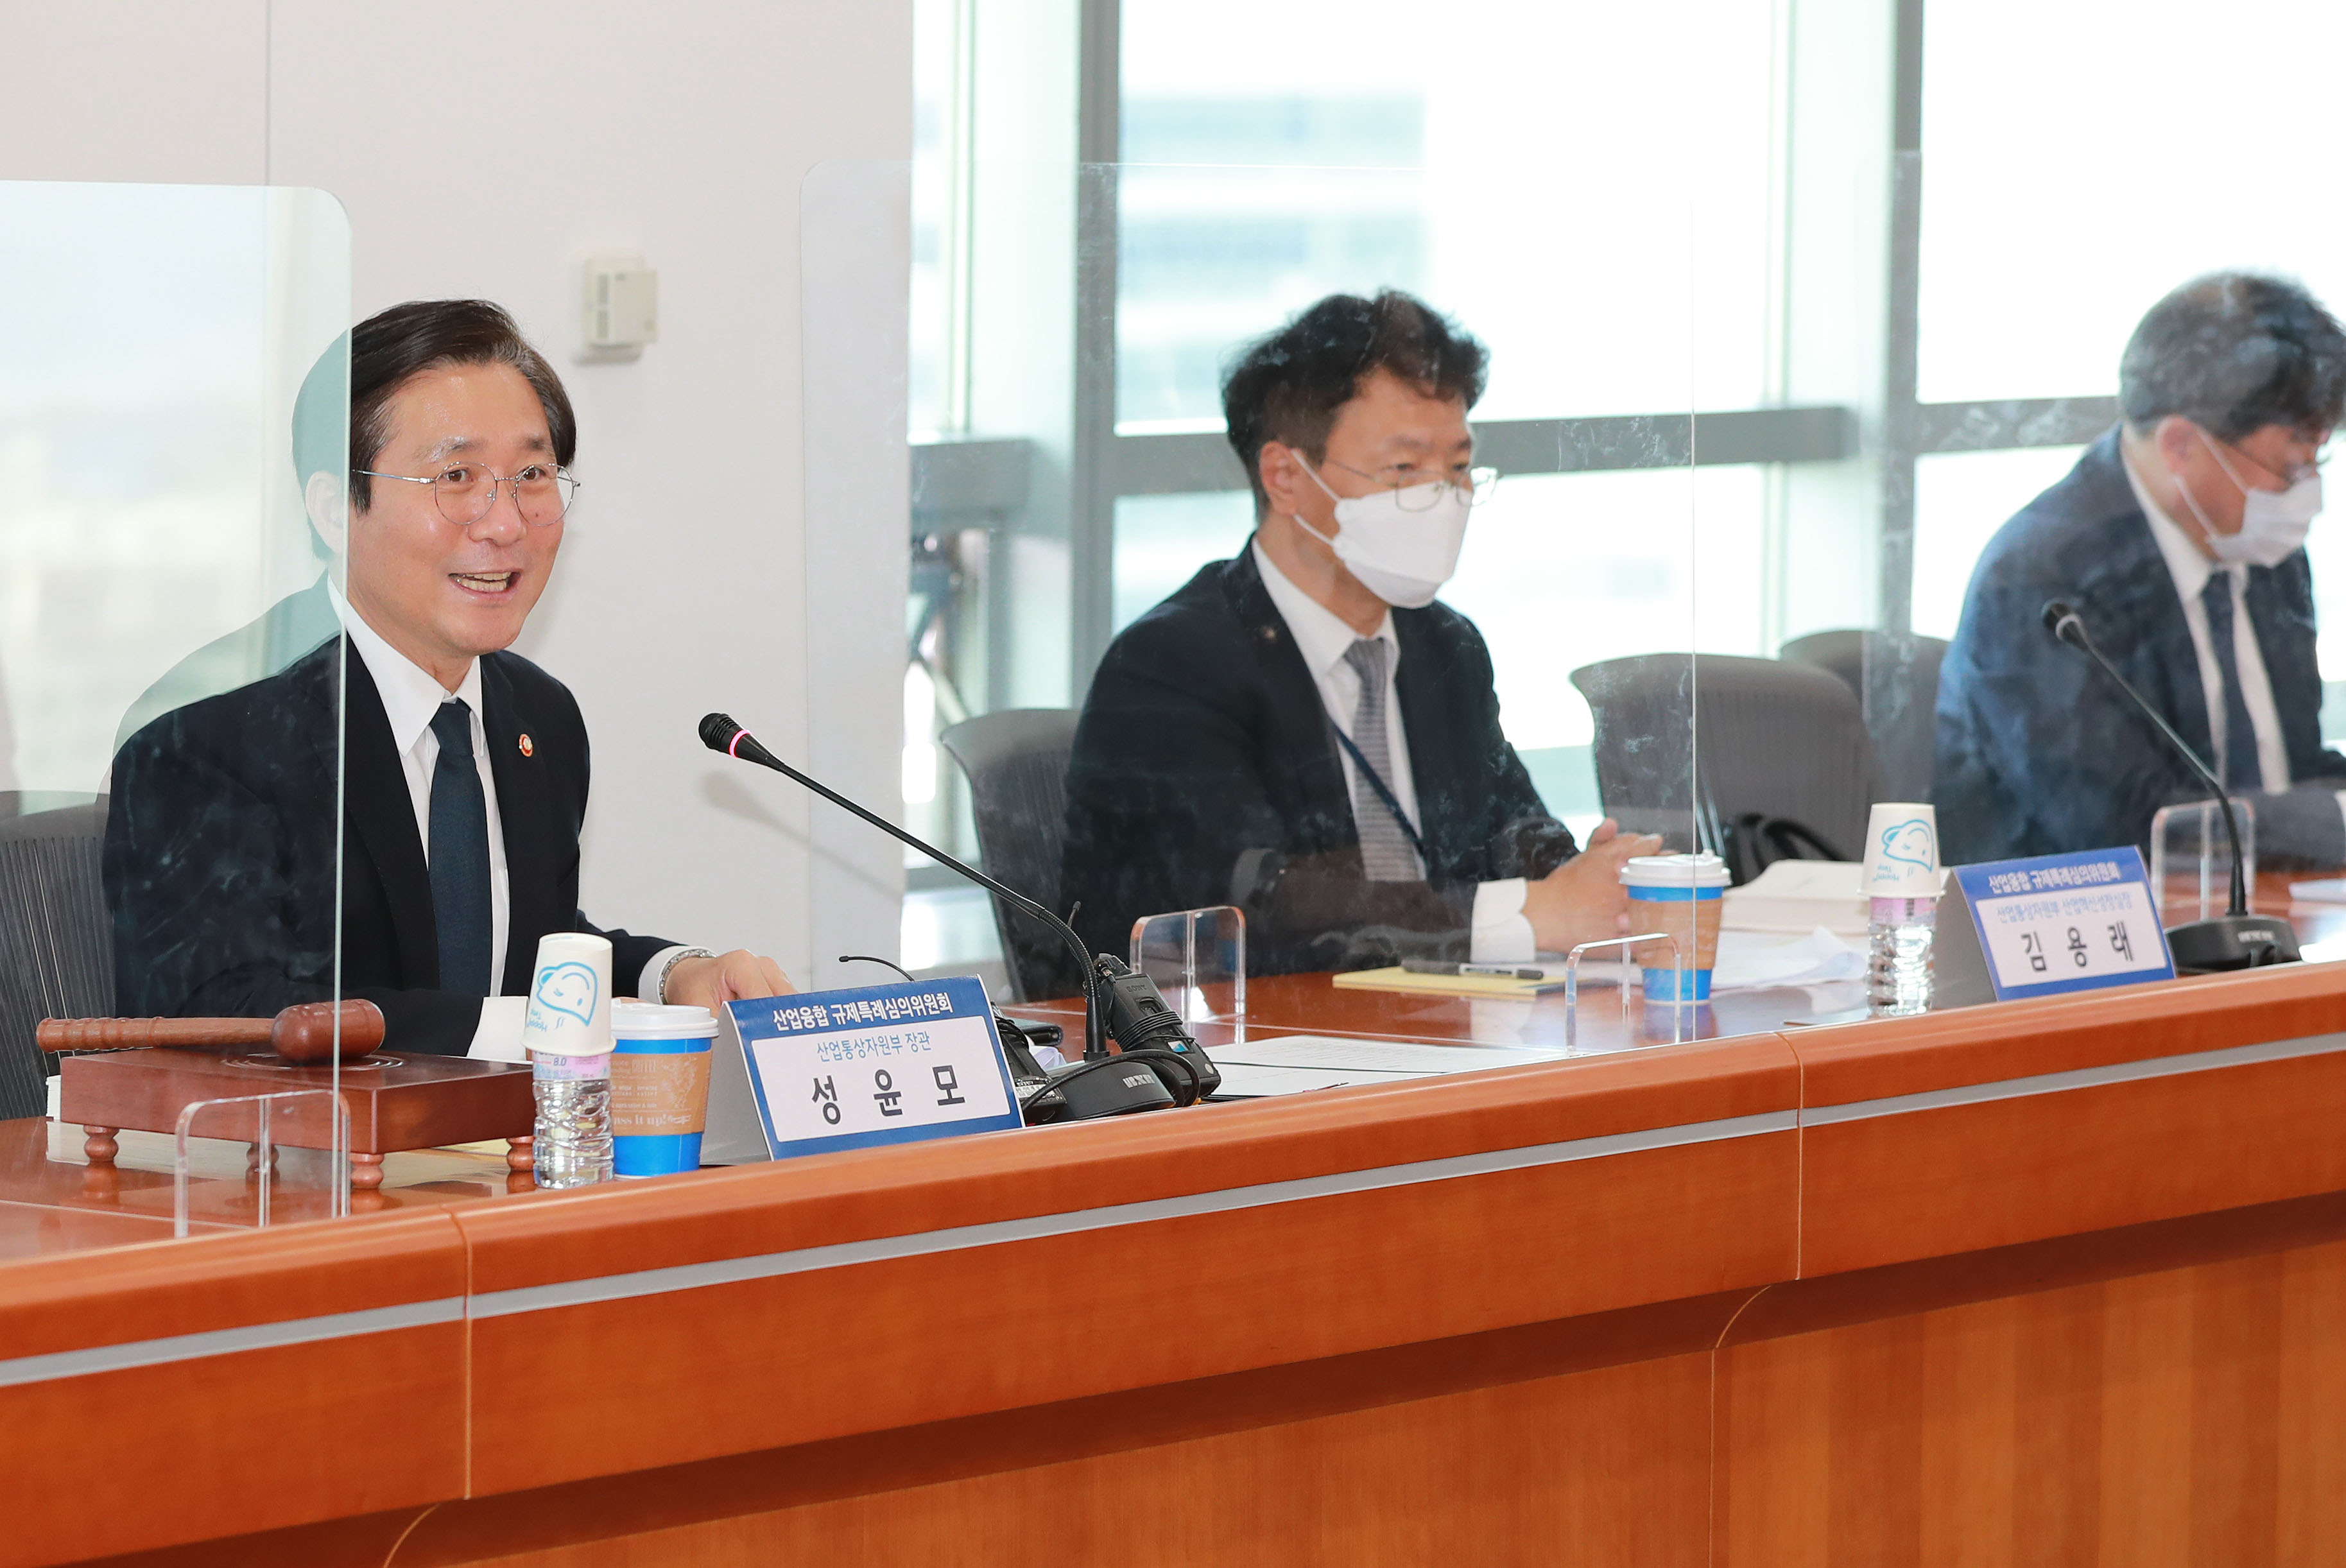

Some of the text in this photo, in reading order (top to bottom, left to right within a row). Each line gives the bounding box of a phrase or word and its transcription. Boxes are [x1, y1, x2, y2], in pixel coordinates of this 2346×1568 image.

[1988, 873, 2031, 894] 산업융합
[2020, 920, 2134, 972] 김 용 래
[772, 992, 953, 1031] 산업융합 규제특례심의위원회
[553, 1057, 567, 1067] 8.0
[816, 1030, 932, 1062] 산업통상자원부 장관
[811, 1064, 966, 1124] 성 윤 모
